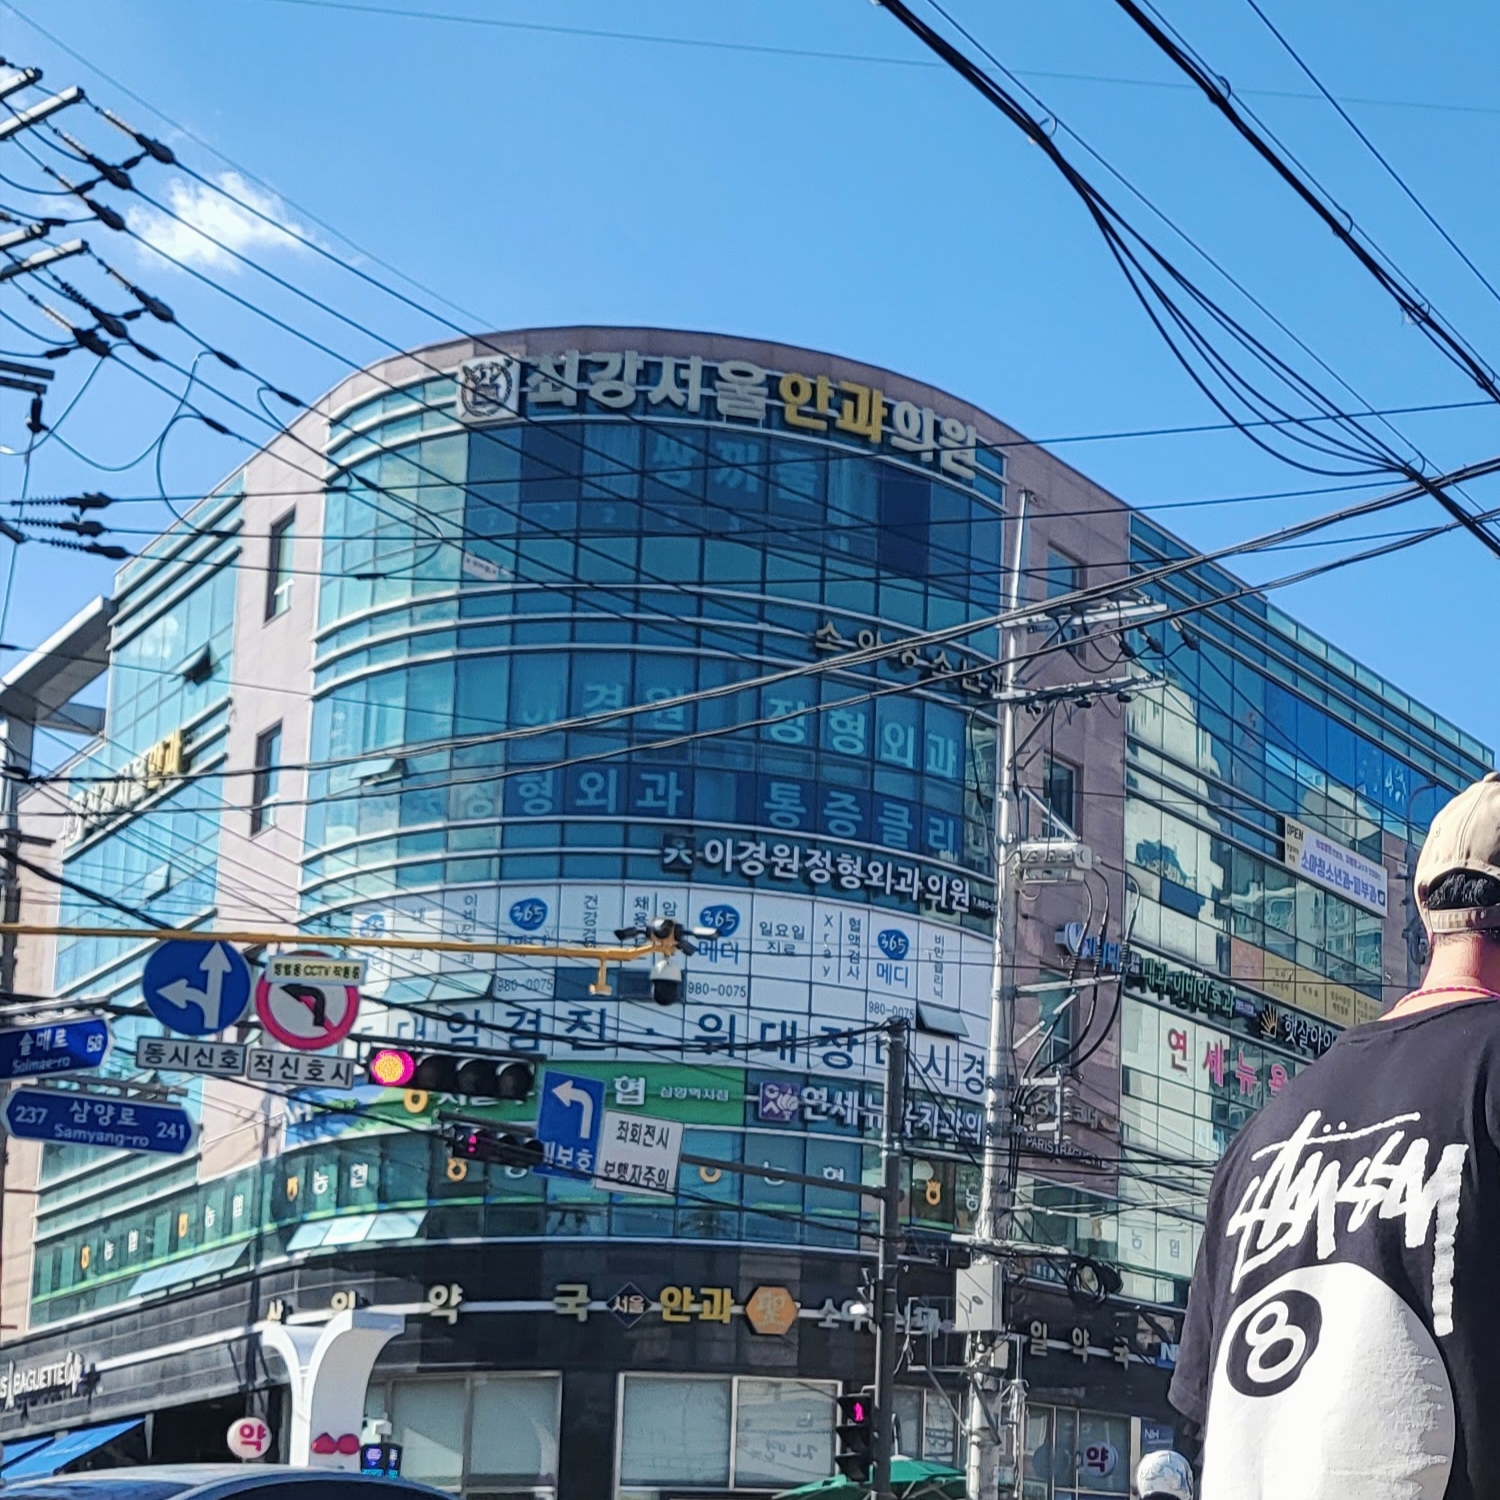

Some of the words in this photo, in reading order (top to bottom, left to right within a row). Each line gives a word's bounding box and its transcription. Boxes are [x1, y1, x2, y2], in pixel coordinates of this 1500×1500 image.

[704, 837, 971, 912] 이경원정형외과의원
[511, 900, 546, 927] 365
[702, 906, 738, 932] 365
[759, 920, 806, 941] 일요일
[879, 931, 908, 957] 365
[697, 939, 740, 965] 메디
[766, 940, 797, 957] 진료
[304, 964, 331, 977] CCTV
[876, 962, 909, 989] 메디
[687, 980, 747, 999] 980-0075
[142, 1043, 241, 1071] 동시신호
[254, 1055, 351, 1086] 적신호시
[14, 1106, 48, 1125] 237
[69, 1100, 140, 1127] 삼양로
[156, 1121, 186, 1141] 241
[54, 1123, 150, 1148] Samyang-ro
[616, 1120, 670, 1150] 좌회전시
[603, 1159, 670, 1191] 보행자주의
[612, 1294, 645, 1314] 서울
[659, 1286, 735, 1324] 안과
[1244, 1300, 1307, 1384] 8
[13, 1361, 66, 1397] BAGUETTE
[238, 1423, 267, 1452] 약
[1086, 1446, 1109, 1474] 약
